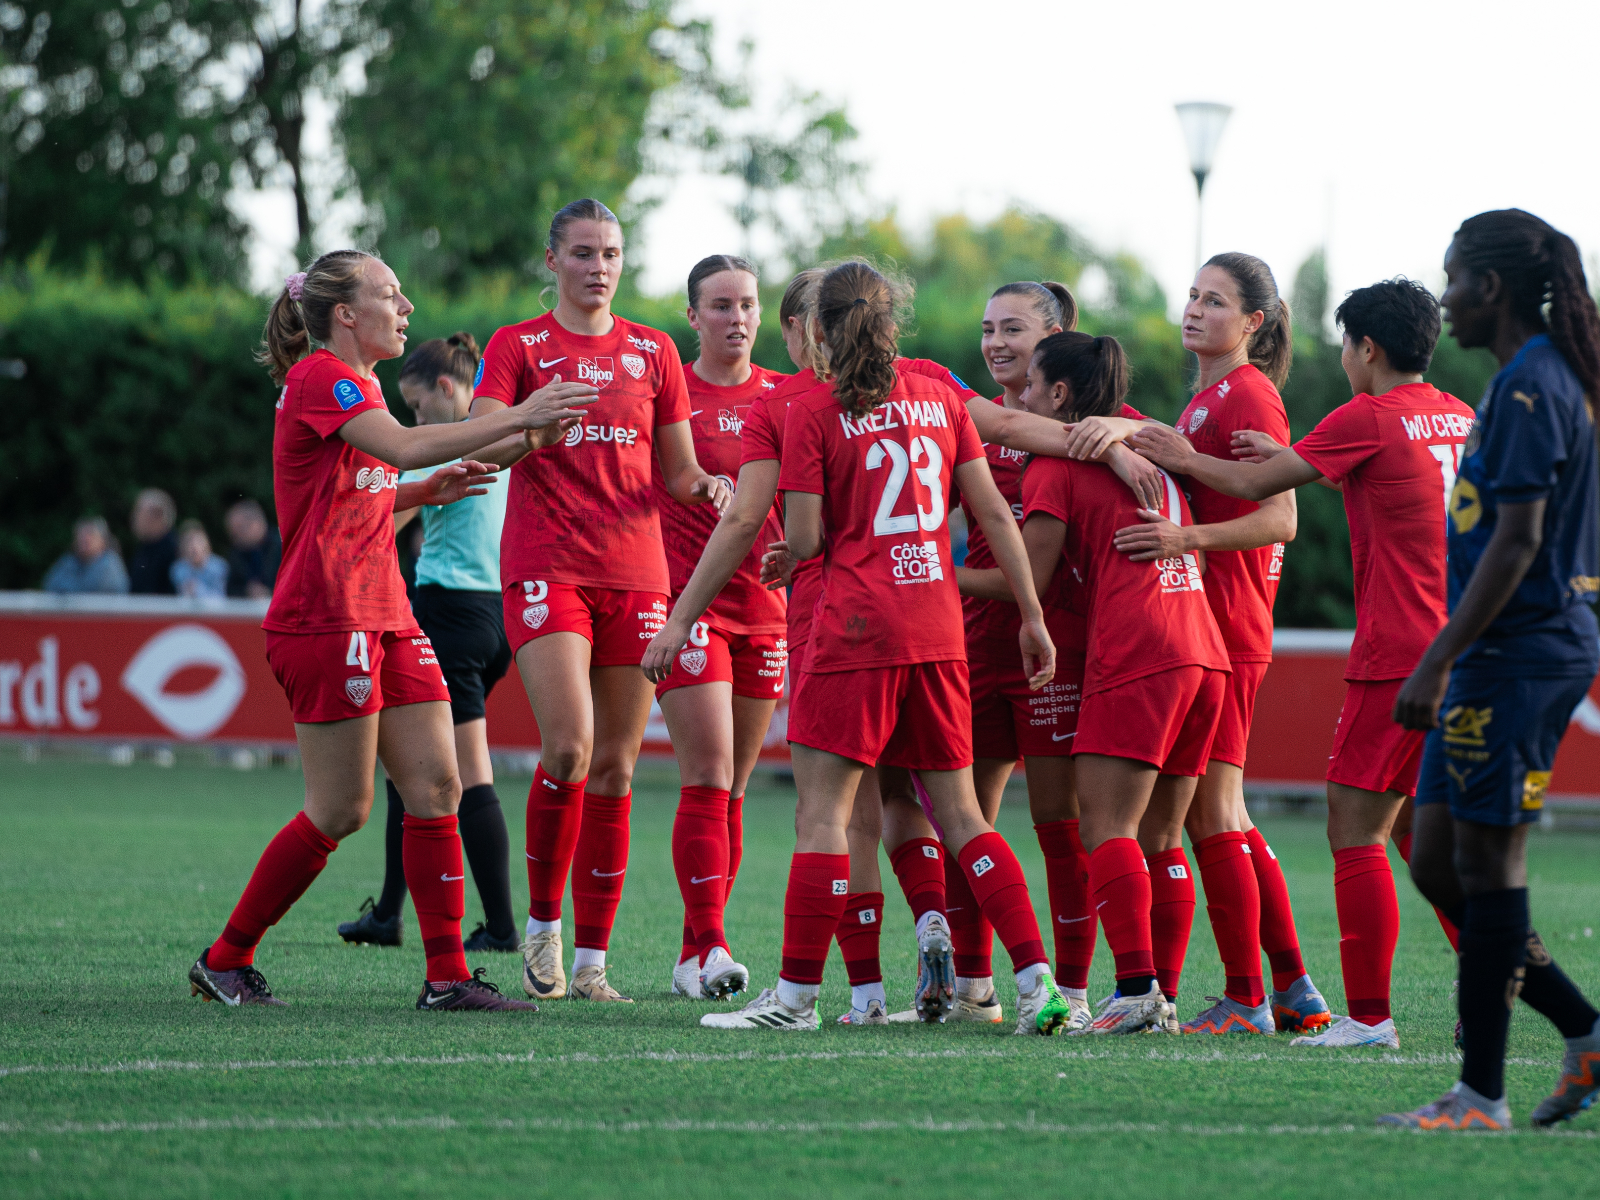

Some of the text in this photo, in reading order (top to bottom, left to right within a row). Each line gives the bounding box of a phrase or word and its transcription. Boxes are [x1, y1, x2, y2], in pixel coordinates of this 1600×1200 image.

[577, 363, 614, 385] Dijon
[838, 400, 948, 439] KREZYMAN
[1400, 414, 1432, 440] WU
[866, 436, 944, 537] 23
[890, 542, 928, 561] Côte
[346, 631, 370, 672] 4
[1034, 705, 1076, 716] FRANCHE
[973, 857, 992, 875] 23
[1171, 867, 1184, 878] 17
[834, 882, 848, 893] 23
